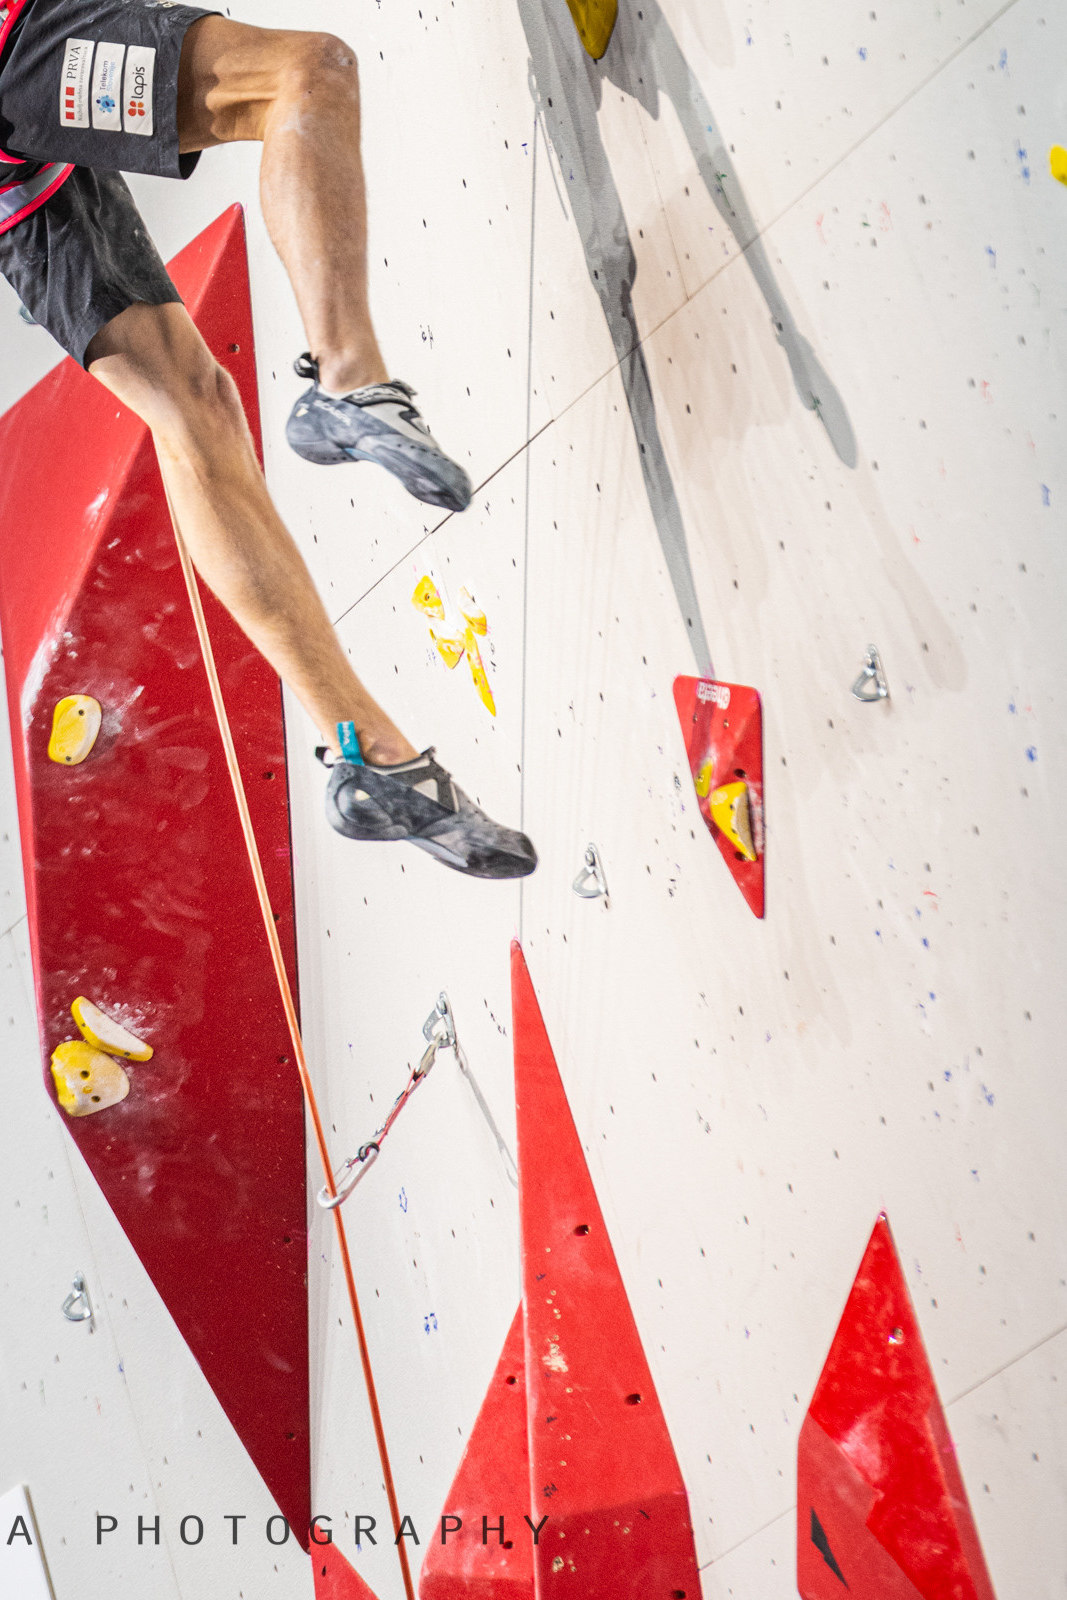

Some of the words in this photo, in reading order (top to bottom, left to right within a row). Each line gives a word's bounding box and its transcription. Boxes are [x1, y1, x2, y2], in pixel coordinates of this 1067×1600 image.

[66, 46, 81, 80] PRVA
[99, 60, 109, 91] Telekom
[131, 66, 148, 99] lapis
